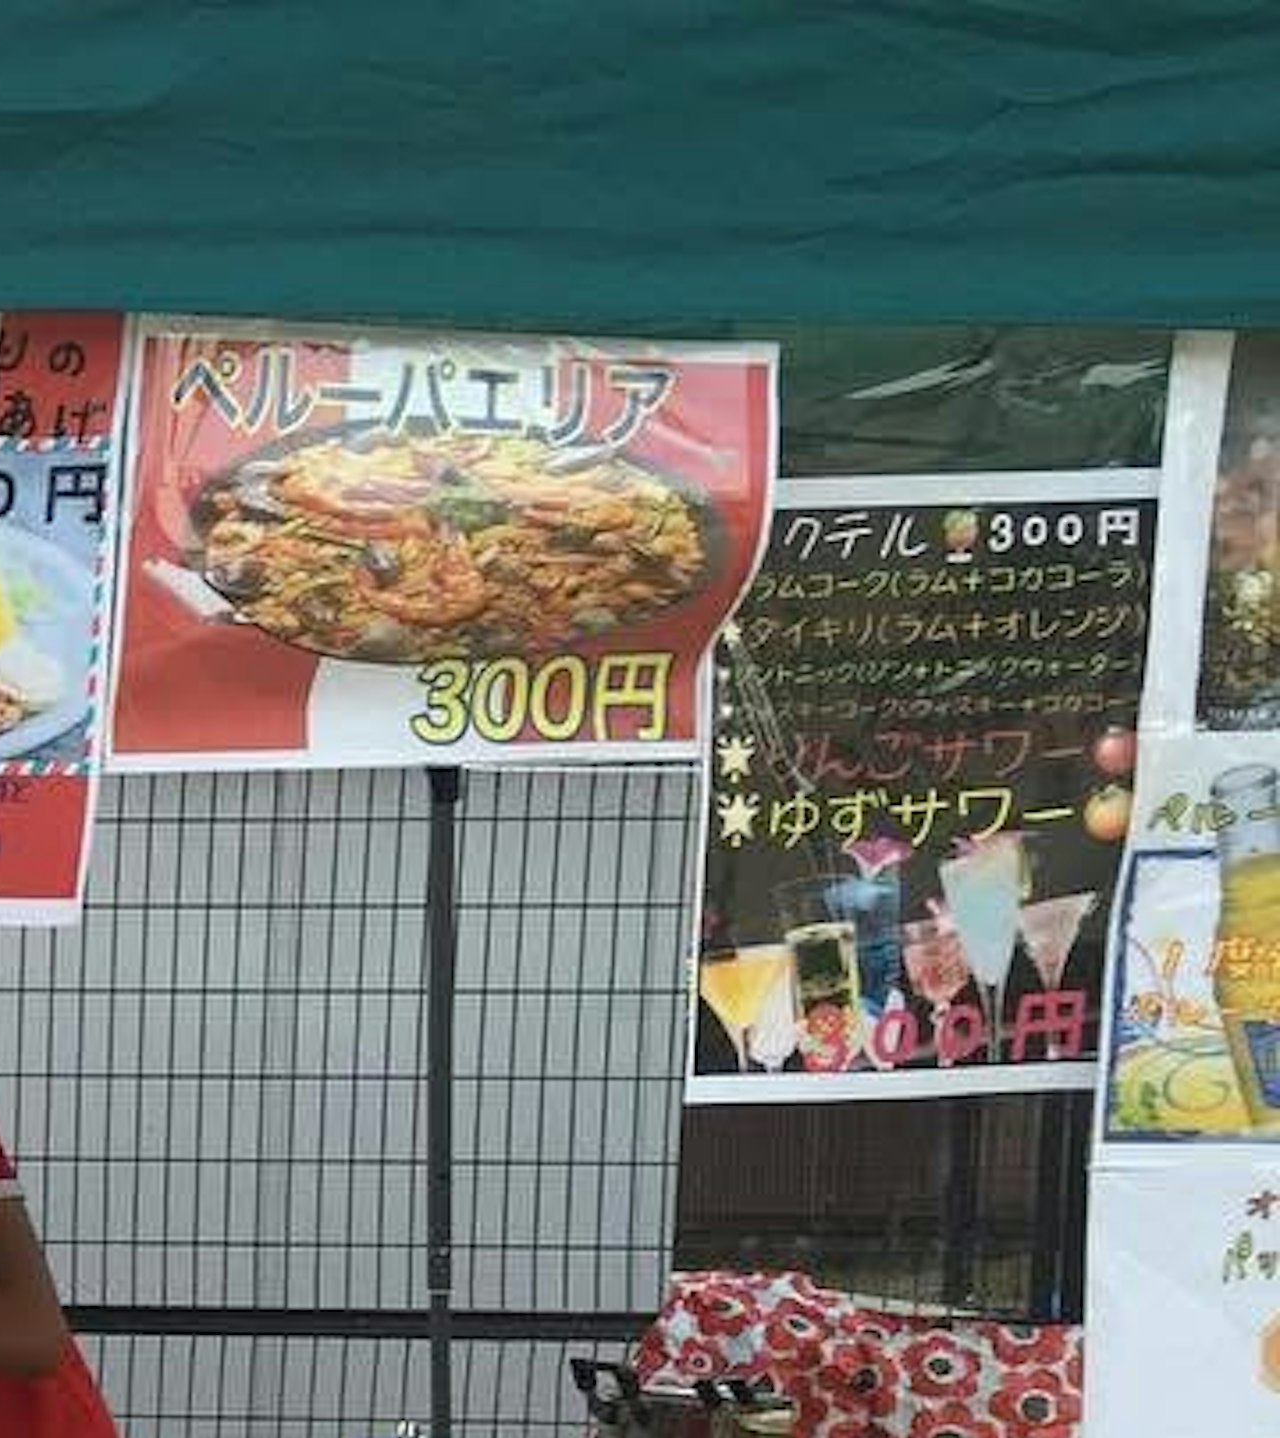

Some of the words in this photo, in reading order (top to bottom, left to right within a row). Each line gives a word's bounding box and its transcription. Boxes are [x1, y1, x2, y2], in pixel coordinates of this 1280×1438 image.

[172, 346, 678, 446] ペルーパエリア
[782, 512, 930, 560] クテル
[988, 509, 1140, 552] 300円
[408, 652, 676, 746] 300円
[770, 788, 1074, 850] ゆずサワー
[798, 988, 1086, 1072] 300円
